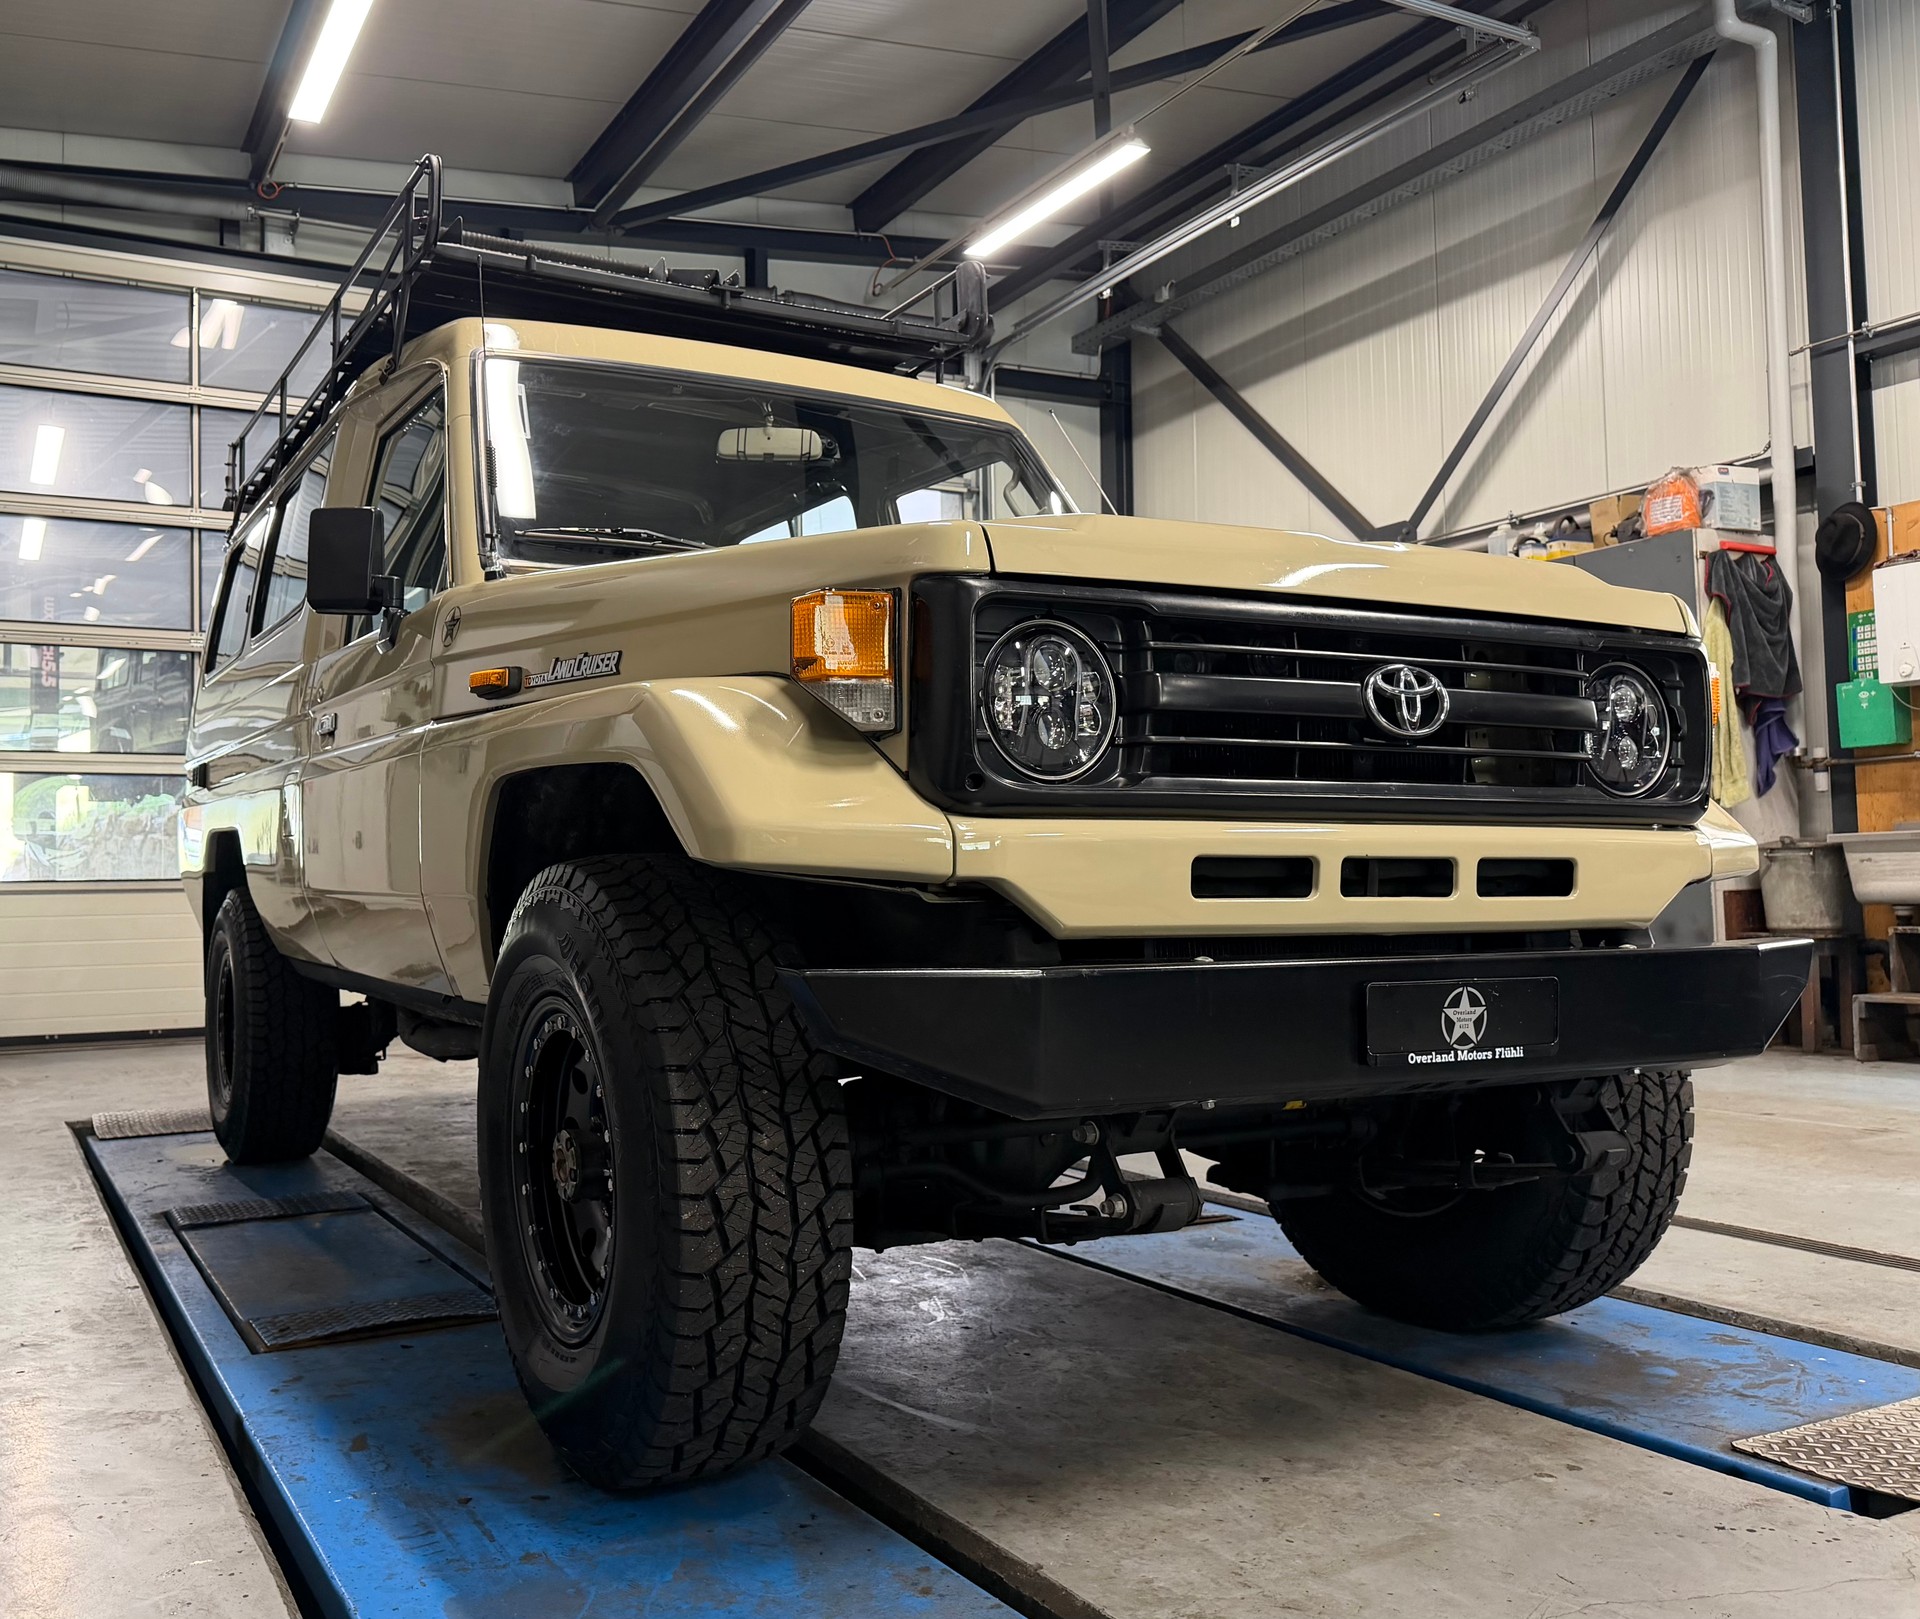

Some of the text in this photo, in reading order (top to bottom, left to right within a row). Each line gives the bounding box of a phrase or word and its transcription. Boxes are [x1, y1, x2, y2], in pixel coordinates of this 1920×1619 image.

[525, 674, 546, 686] TOYOTA
[1408, 1047, 1523, 1064] Overland Motors Flühli
